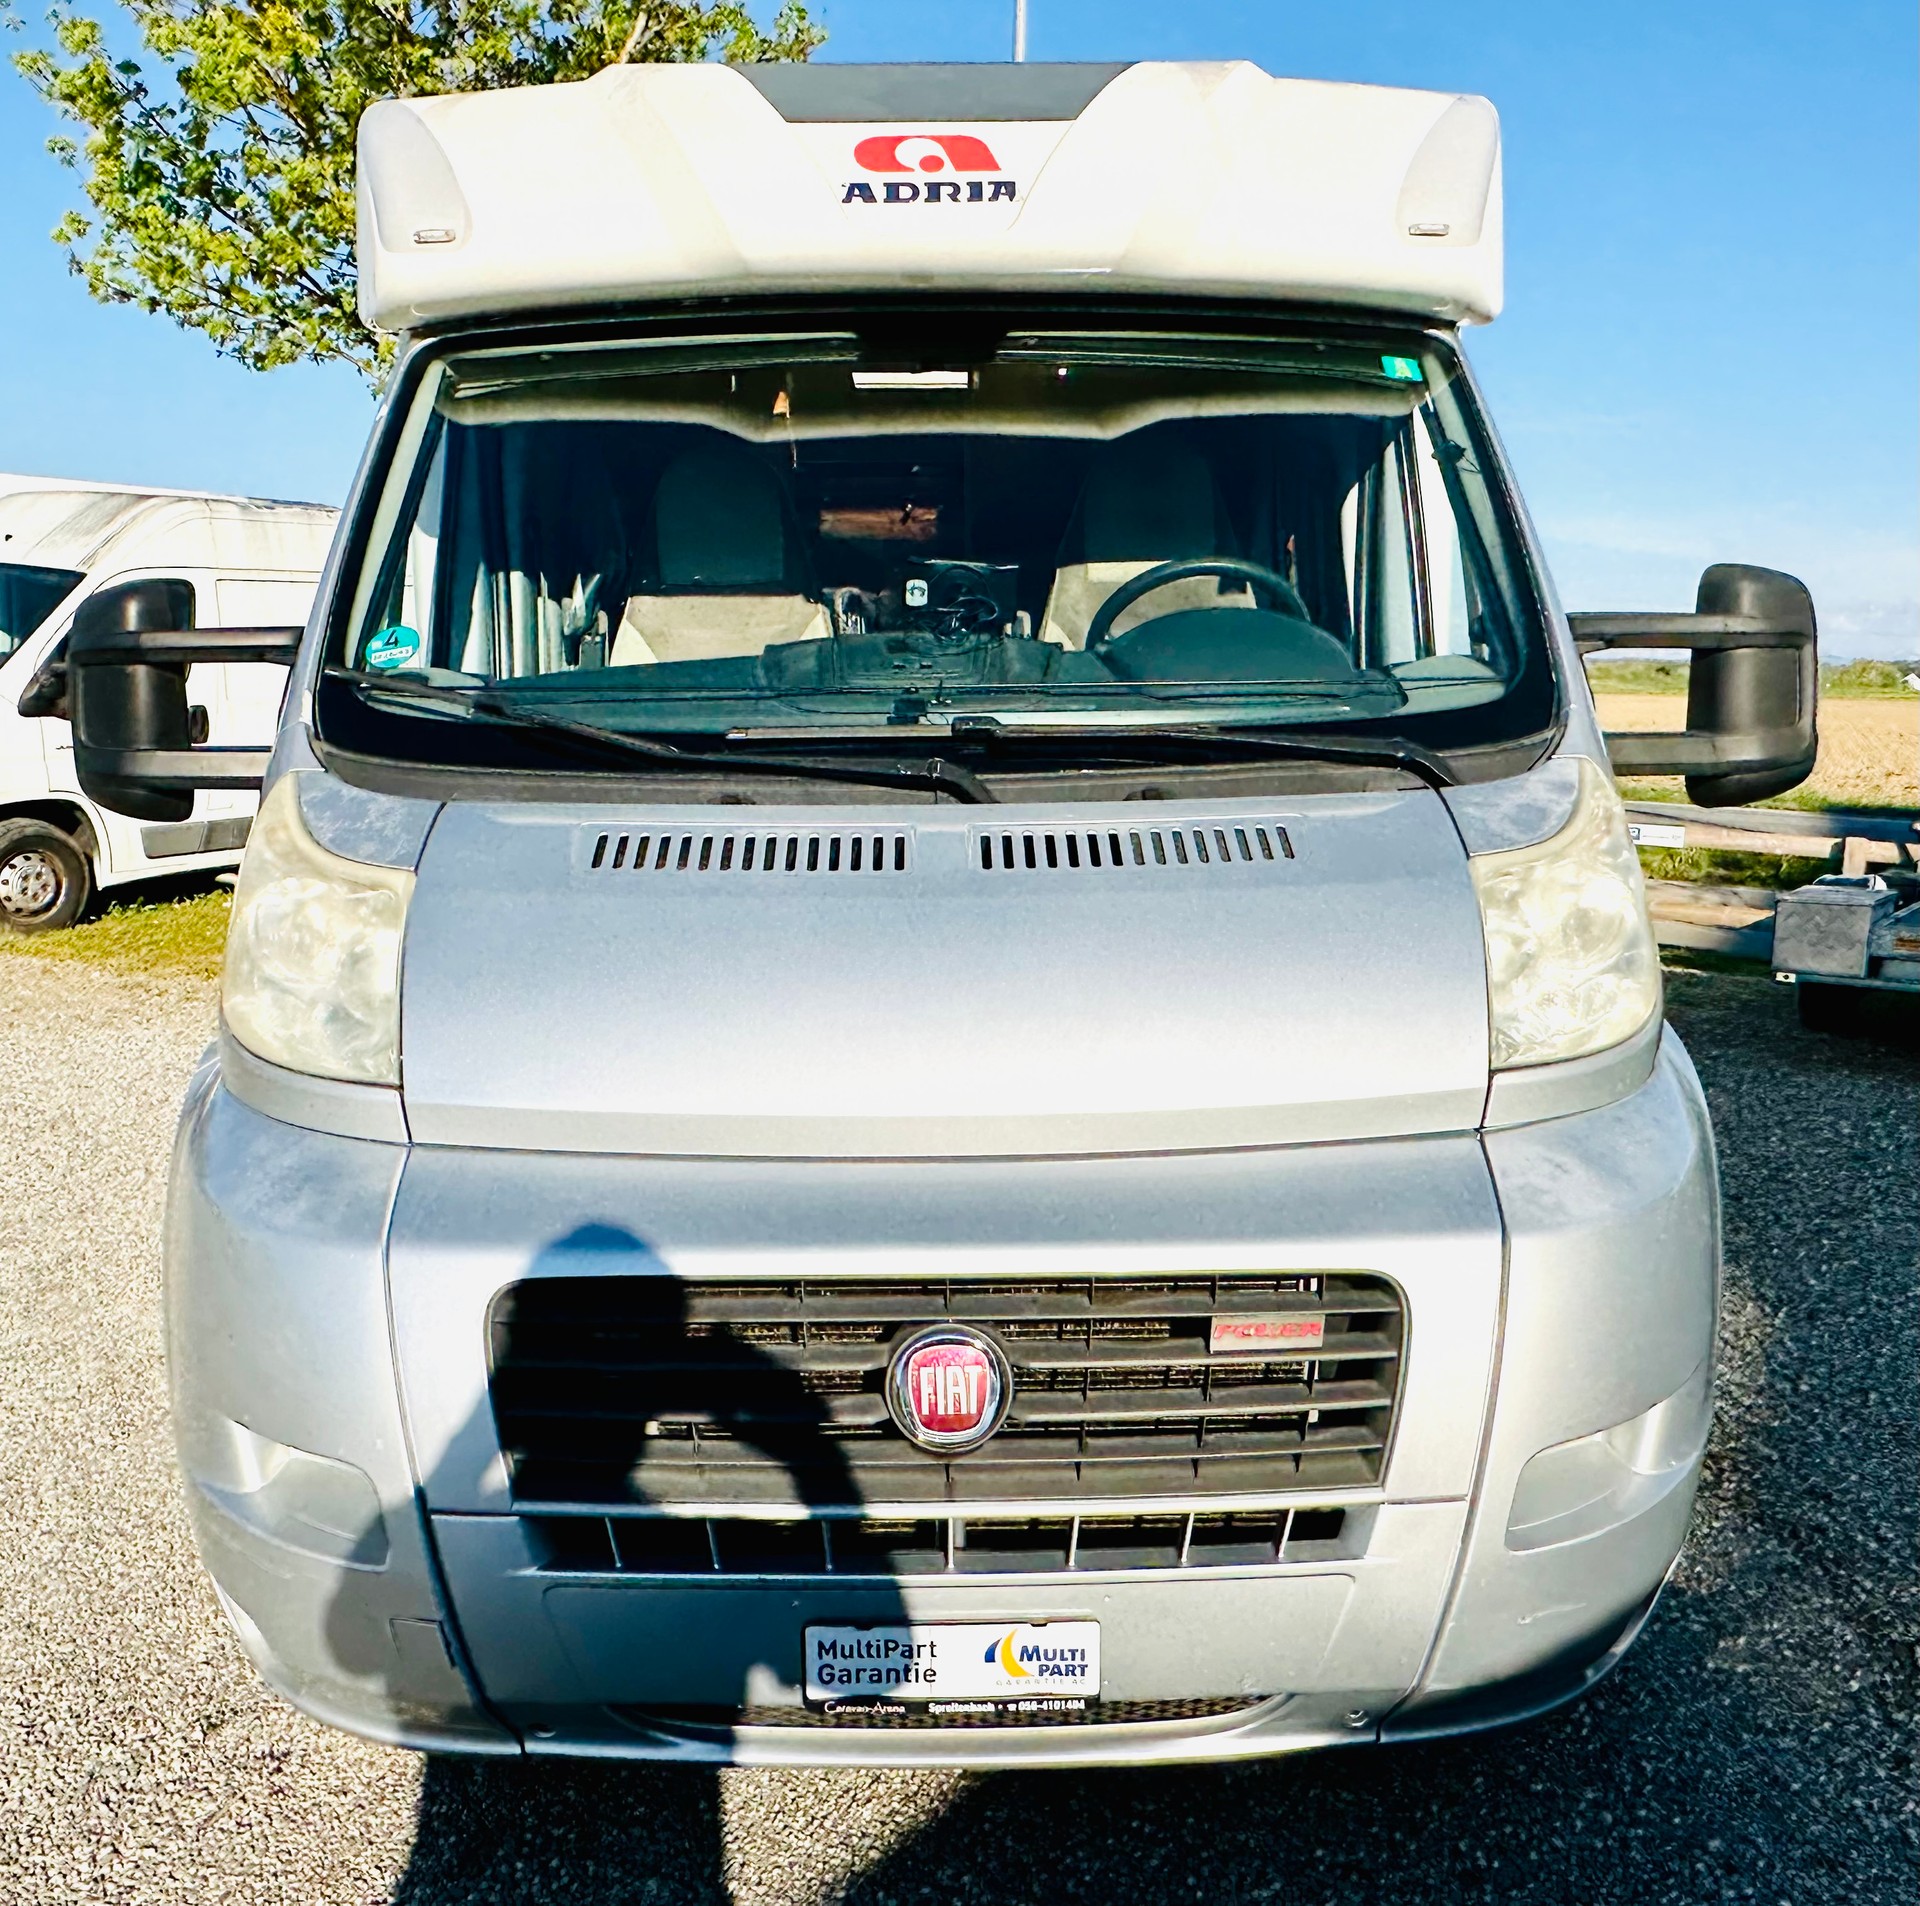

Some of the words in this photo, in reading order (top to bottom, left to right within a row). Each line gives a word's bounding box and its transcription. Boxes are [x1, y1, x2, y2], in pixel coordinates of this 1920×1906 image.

[841, 181, 1018, 204] ADRIA
[382, 629, 399, 647] 4
[1213, 1322, 1322, 1339] POWER
[919, 1365, 983, 1416] FIAT
[817, 1639, 937, 1660] MultiPart
[1019, 1645, 1086, 1662] MULTI
[817, 1662, 937, 1685] Garantie
[1038, 1664, 1089, 1677] PART
